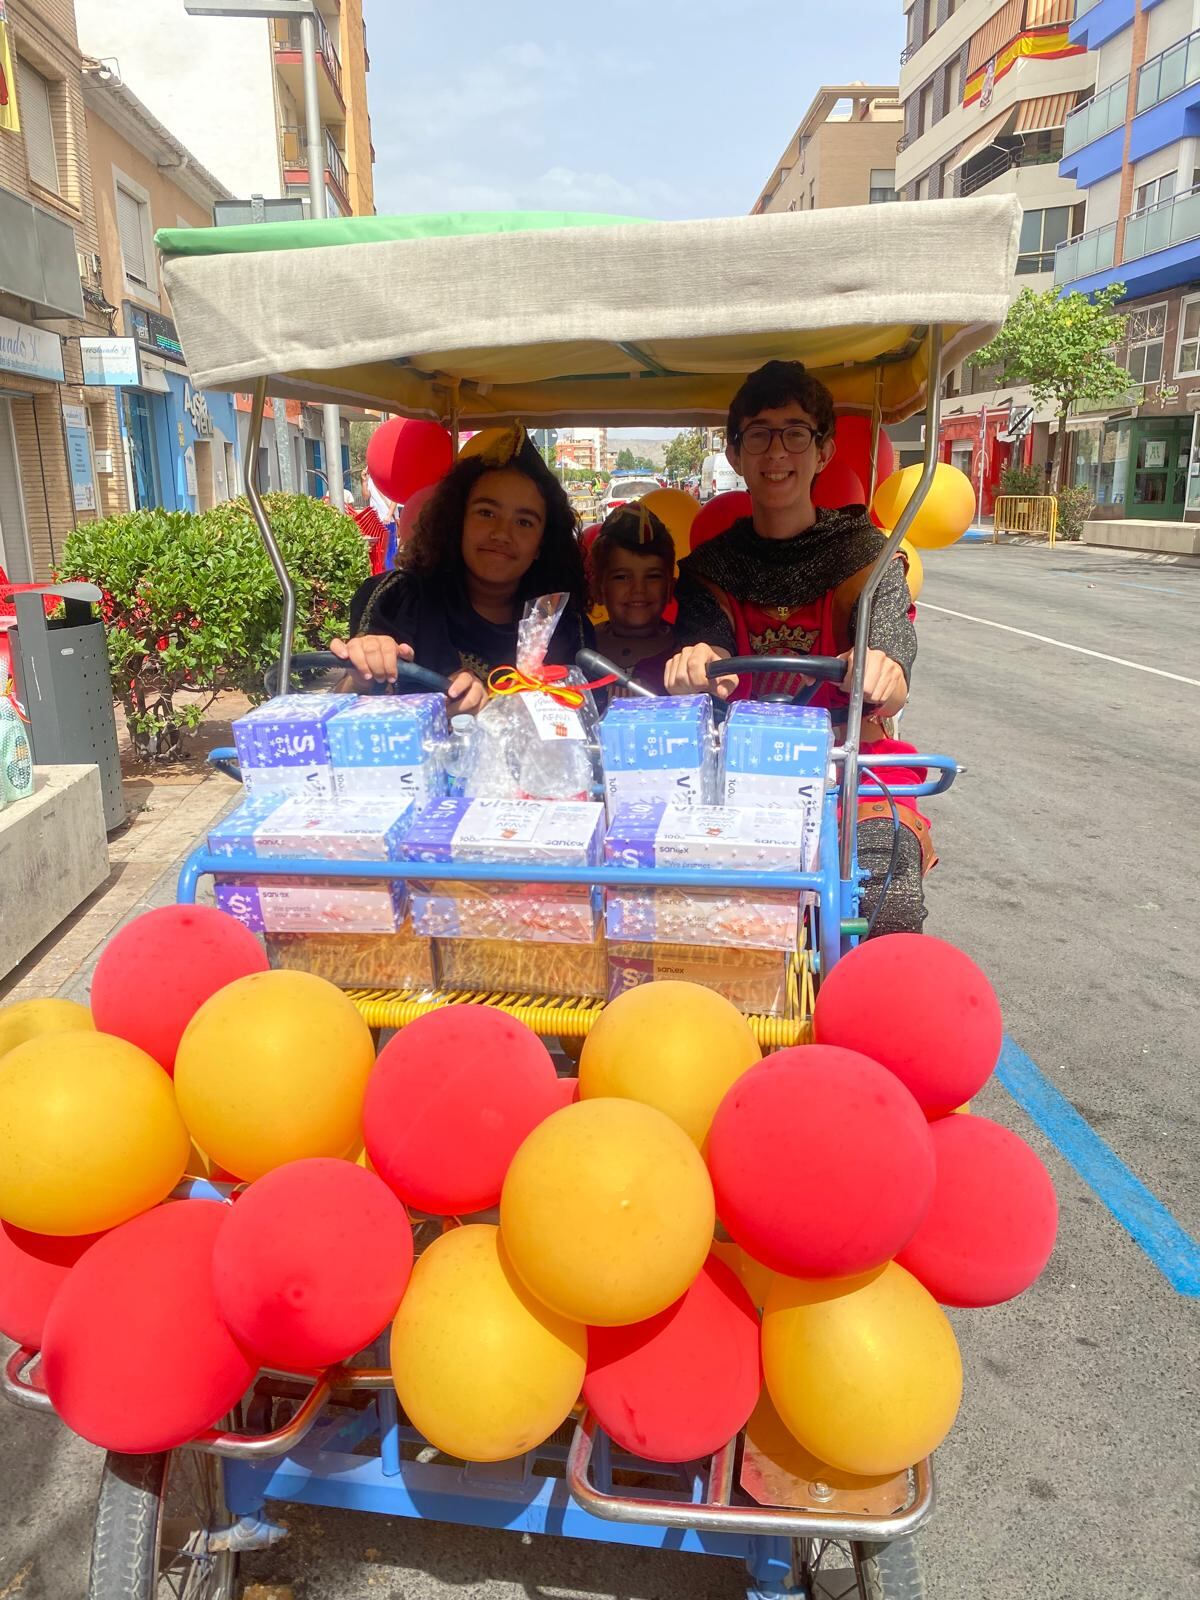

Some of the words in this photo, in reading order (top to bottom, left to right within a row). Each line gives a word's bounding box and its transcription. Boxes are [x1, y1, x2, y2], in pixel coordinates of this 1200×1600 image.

[293, 735, 315, 752] S
[389, 735, 411, 751] L
[666, 738, 689, 754] L
[774, 741, 785, 762] 8-9
[793, 745, 818, 761] L
[622, 848, 639, 868] S
[229, 895, 247, 914] S
[622, 968, 640, 987] S
